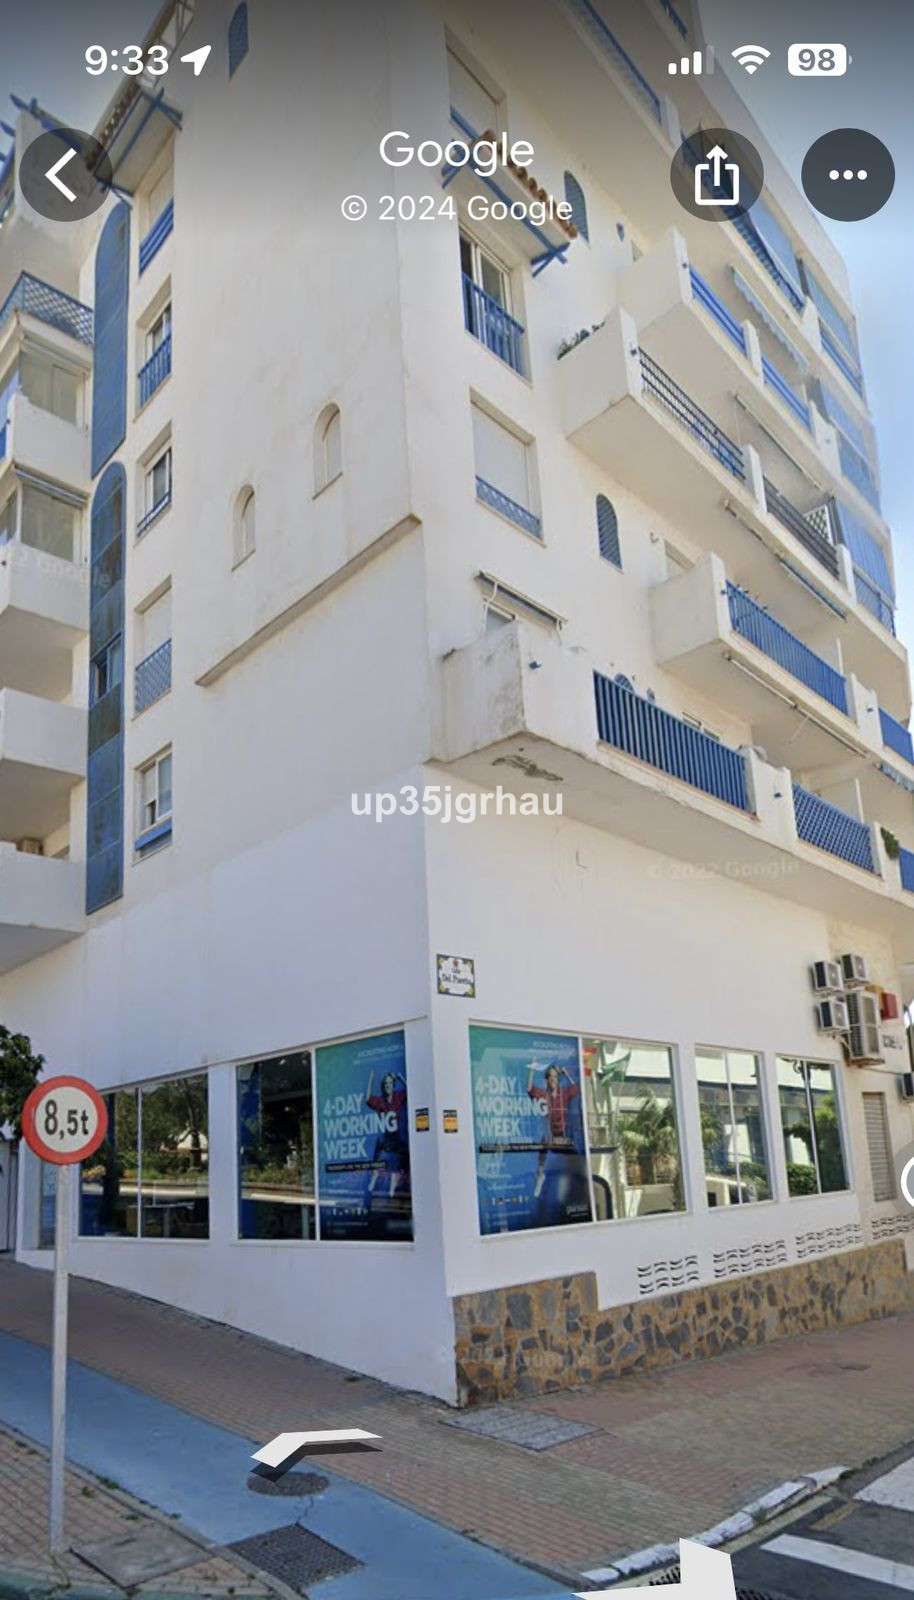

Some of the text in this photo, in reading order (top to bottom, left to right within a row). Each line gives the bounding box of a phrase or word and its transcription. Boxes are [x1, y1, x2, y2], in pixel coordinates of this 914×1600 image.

[475, 1075, 518, 1095] 4-DAY
[324, 1093, 364, 1116] 4-DAY
[476, 1096, 549, 1117] WORKING
[44, 1099, 89, 1139] 8,5t
[323, 1111, 398, 1139] WORKING
[478, 1117, 522, 1137] WEEK
[324, 1138, 367, 1160] WEEK
